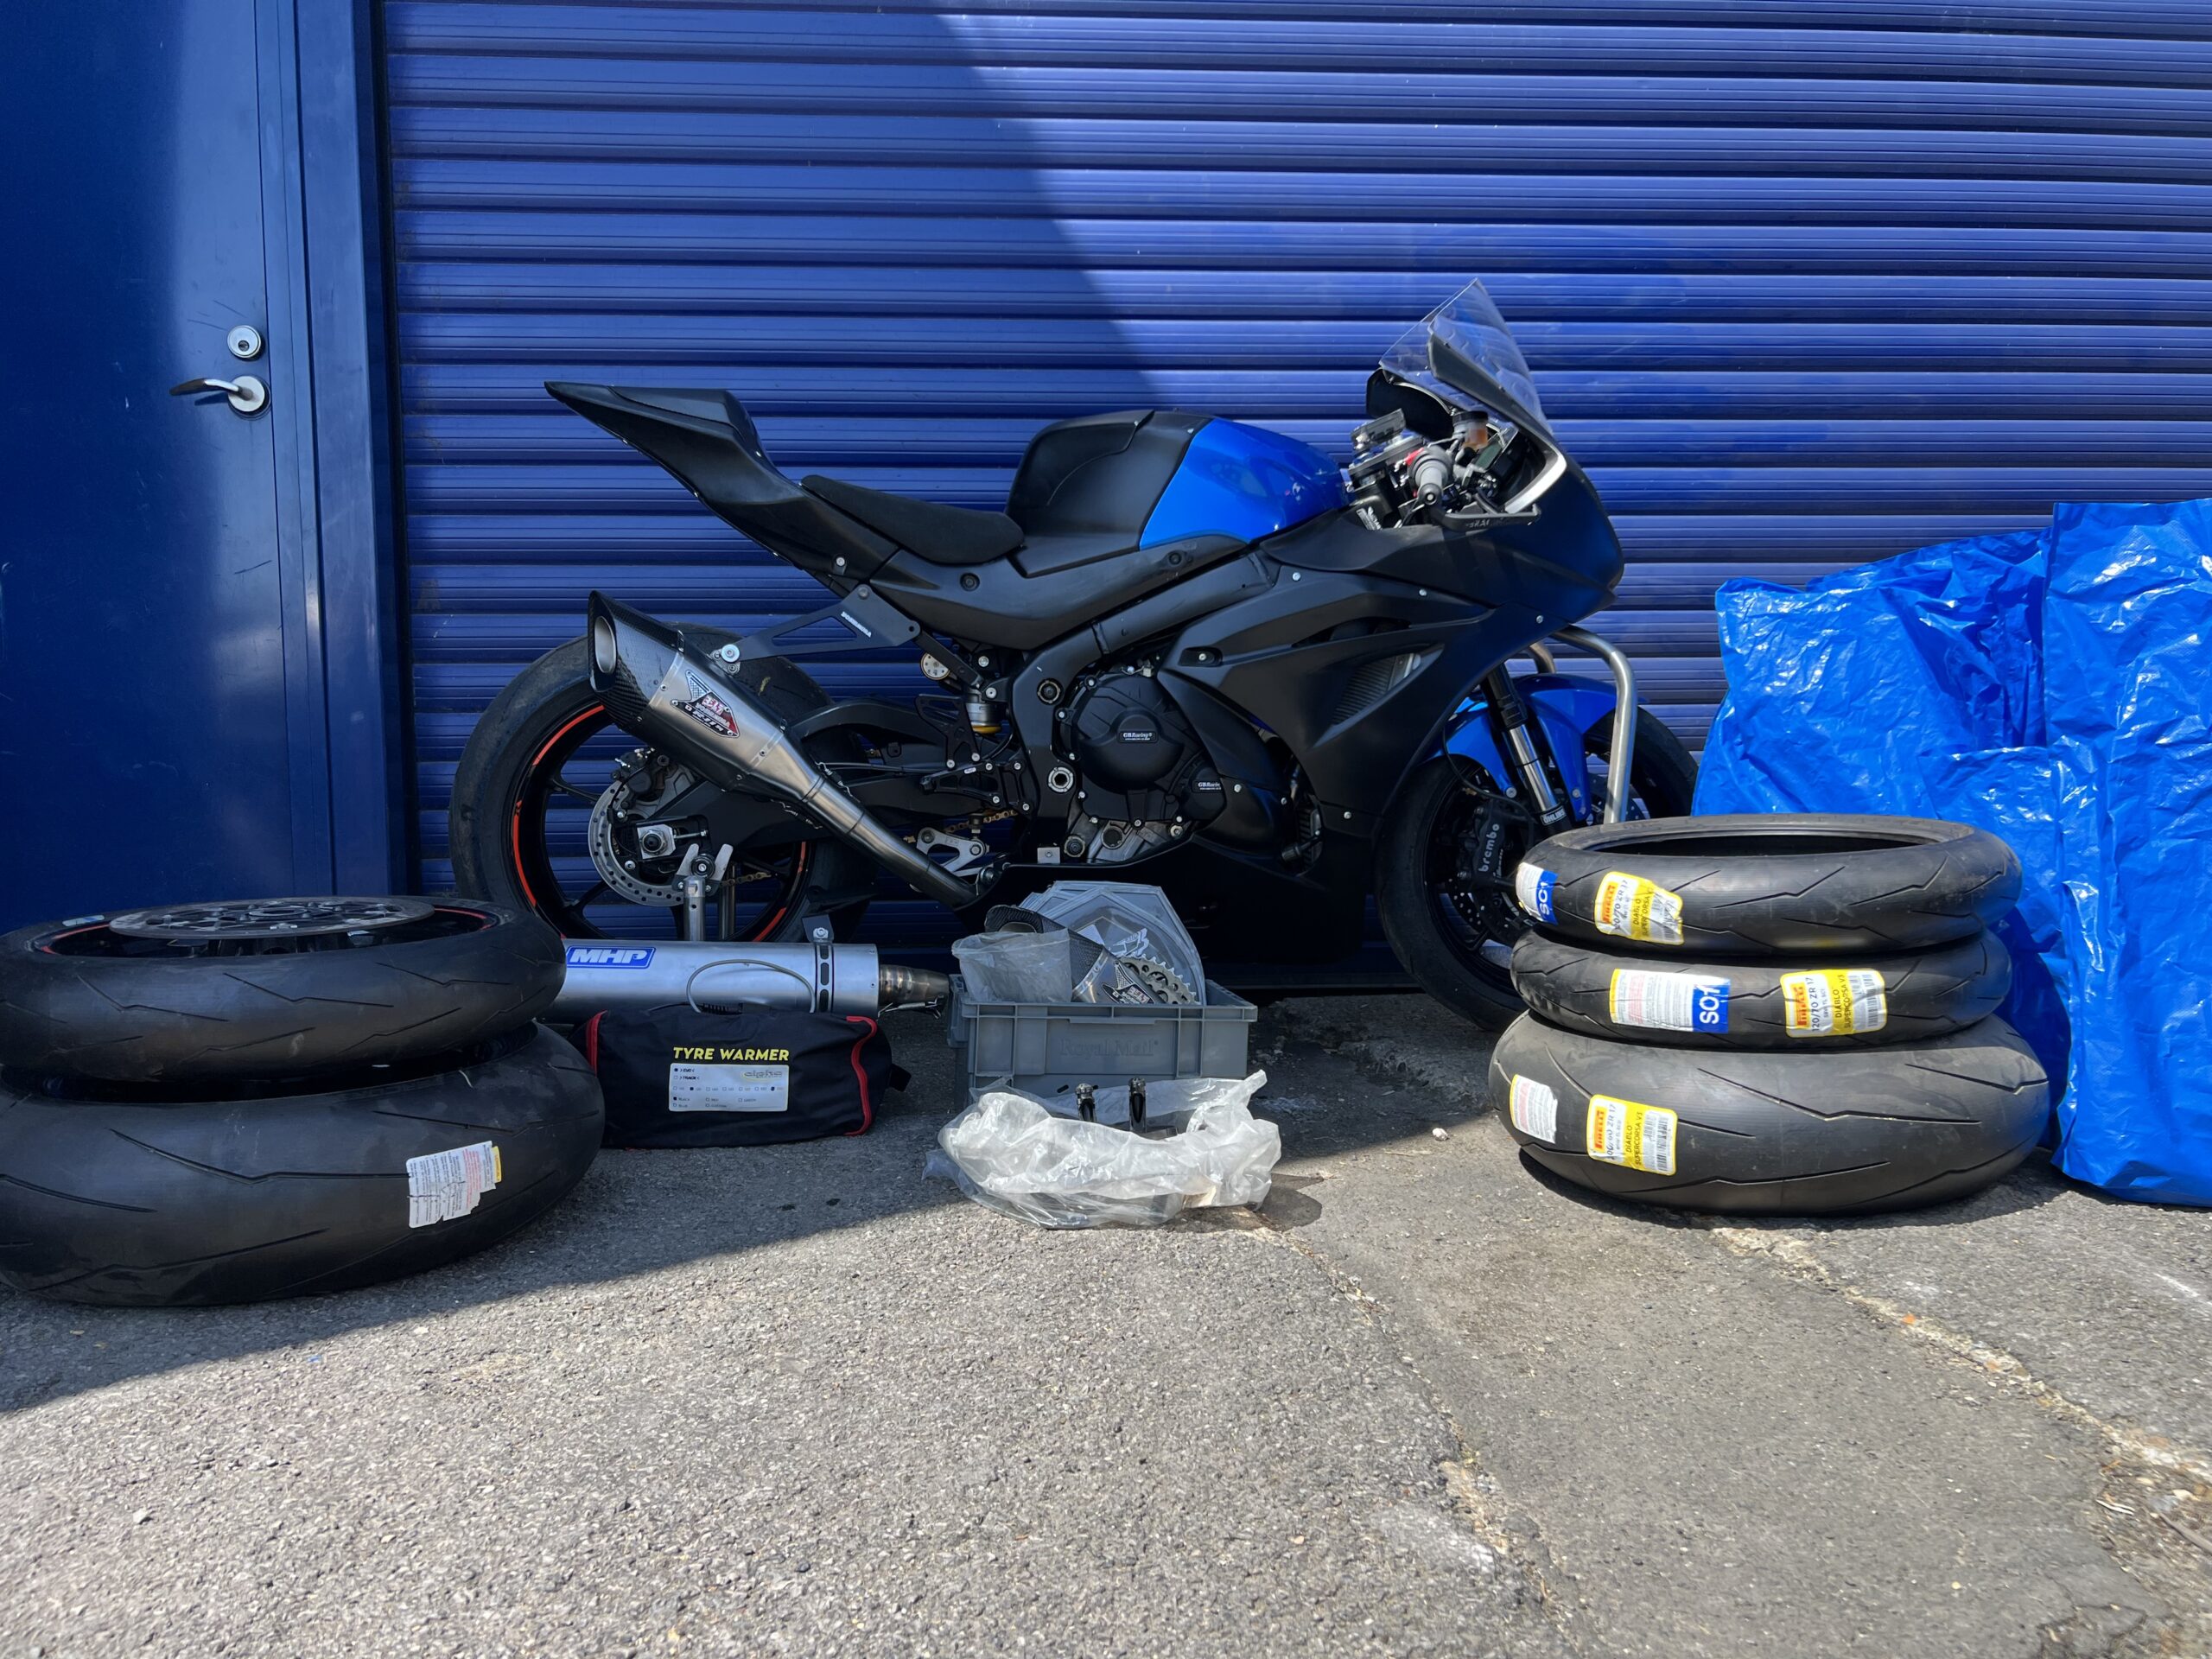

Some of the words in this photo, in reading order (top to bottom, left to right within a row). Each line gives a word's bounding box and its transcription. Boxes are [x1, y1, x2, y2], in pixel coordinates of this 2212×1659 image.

[1478, 823, 1500, 872] brembo
[569, 949, 648, 963] MHP
[1808, 988, 1817, 999] ZR
[1833, 989, 1841, 1018] DIABLO
[1811, 1001, 1820, 1032] 120/70
[1841, 985, 1852, 1028] SUPERCORSA
[673, 1047, 715, 1060] TYRE
[720, 1048, 790, 1061] WARMER
[1060, 1039, 1109, 1059] Royal
[1114, 1039, 1154, 1056] Mail
